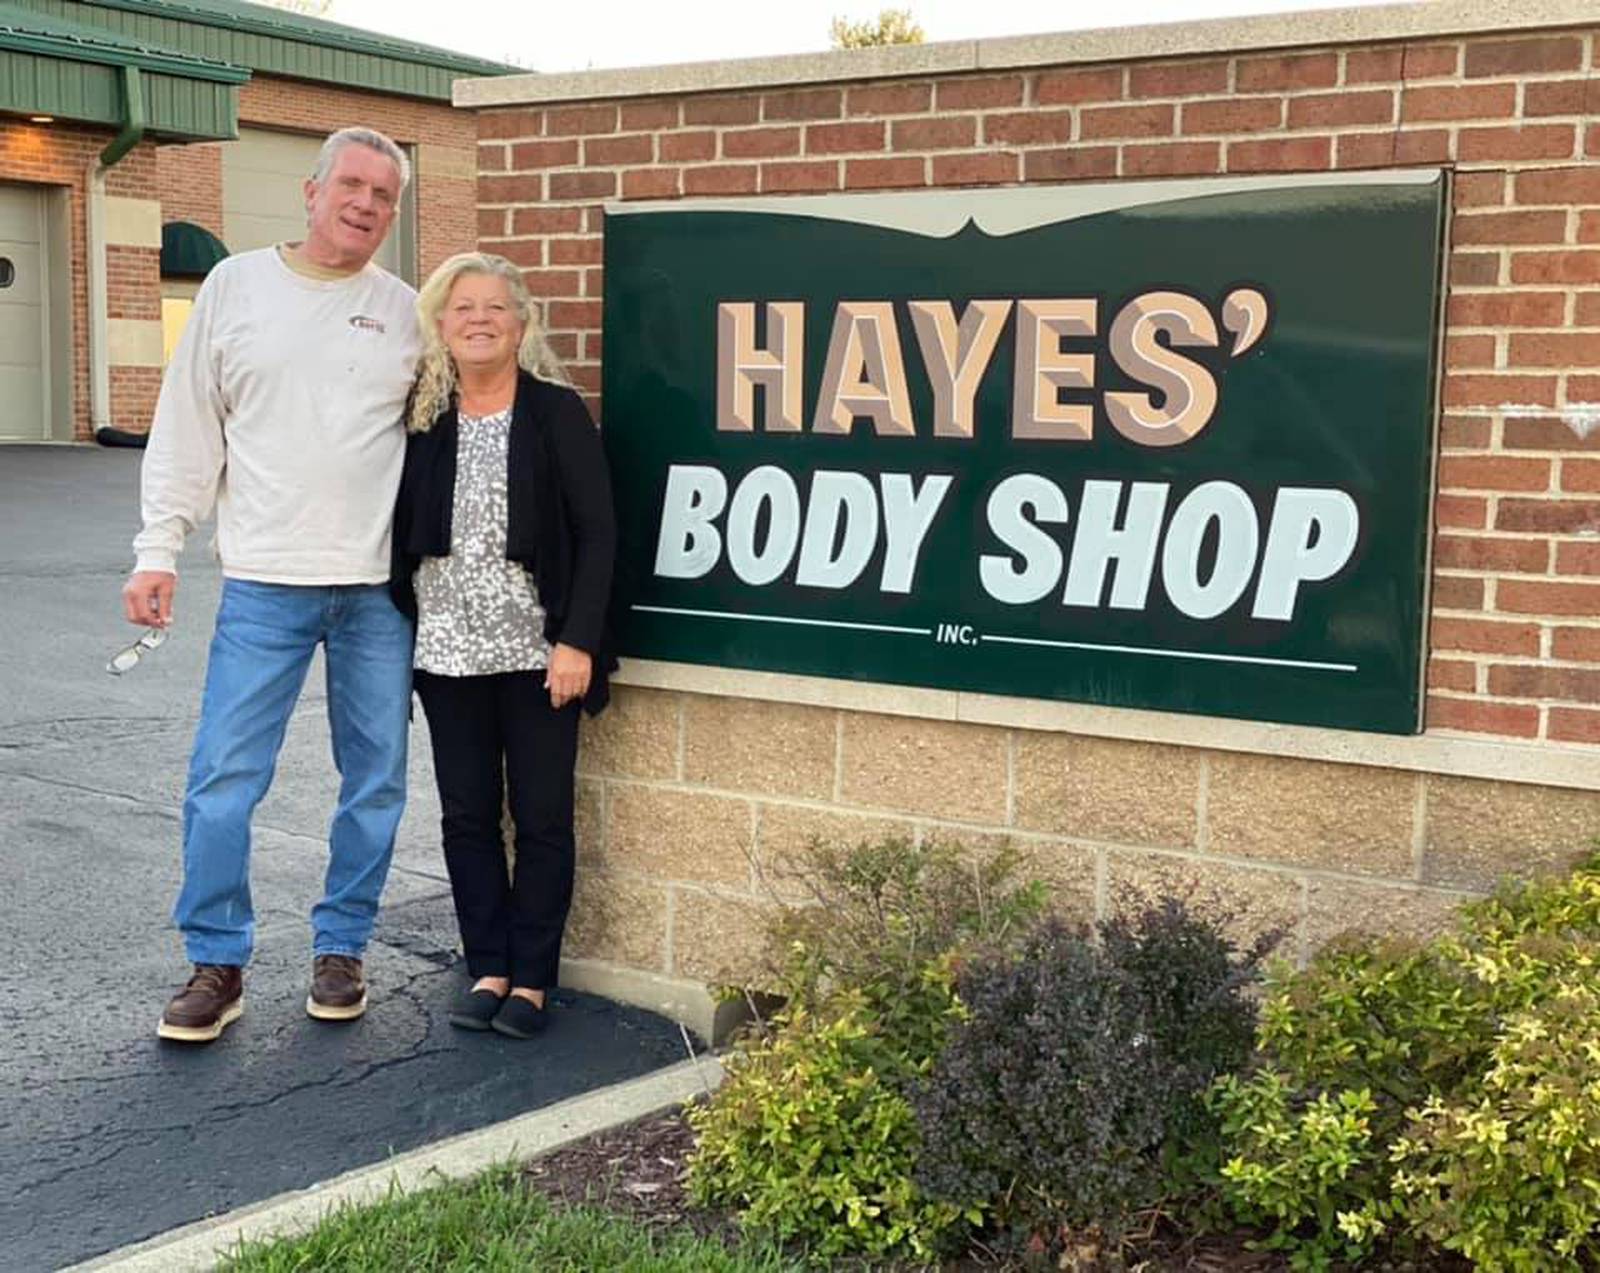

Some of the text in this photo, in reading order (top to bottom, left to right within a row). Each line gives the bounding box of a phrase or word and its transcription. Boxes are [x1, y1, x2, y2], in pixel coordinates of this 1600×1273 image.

[717, 288, 1268, 447] HAYES'
[654, 465, 1360, 622] BODY SHOP
[936, 623, 978, 646] INC.
